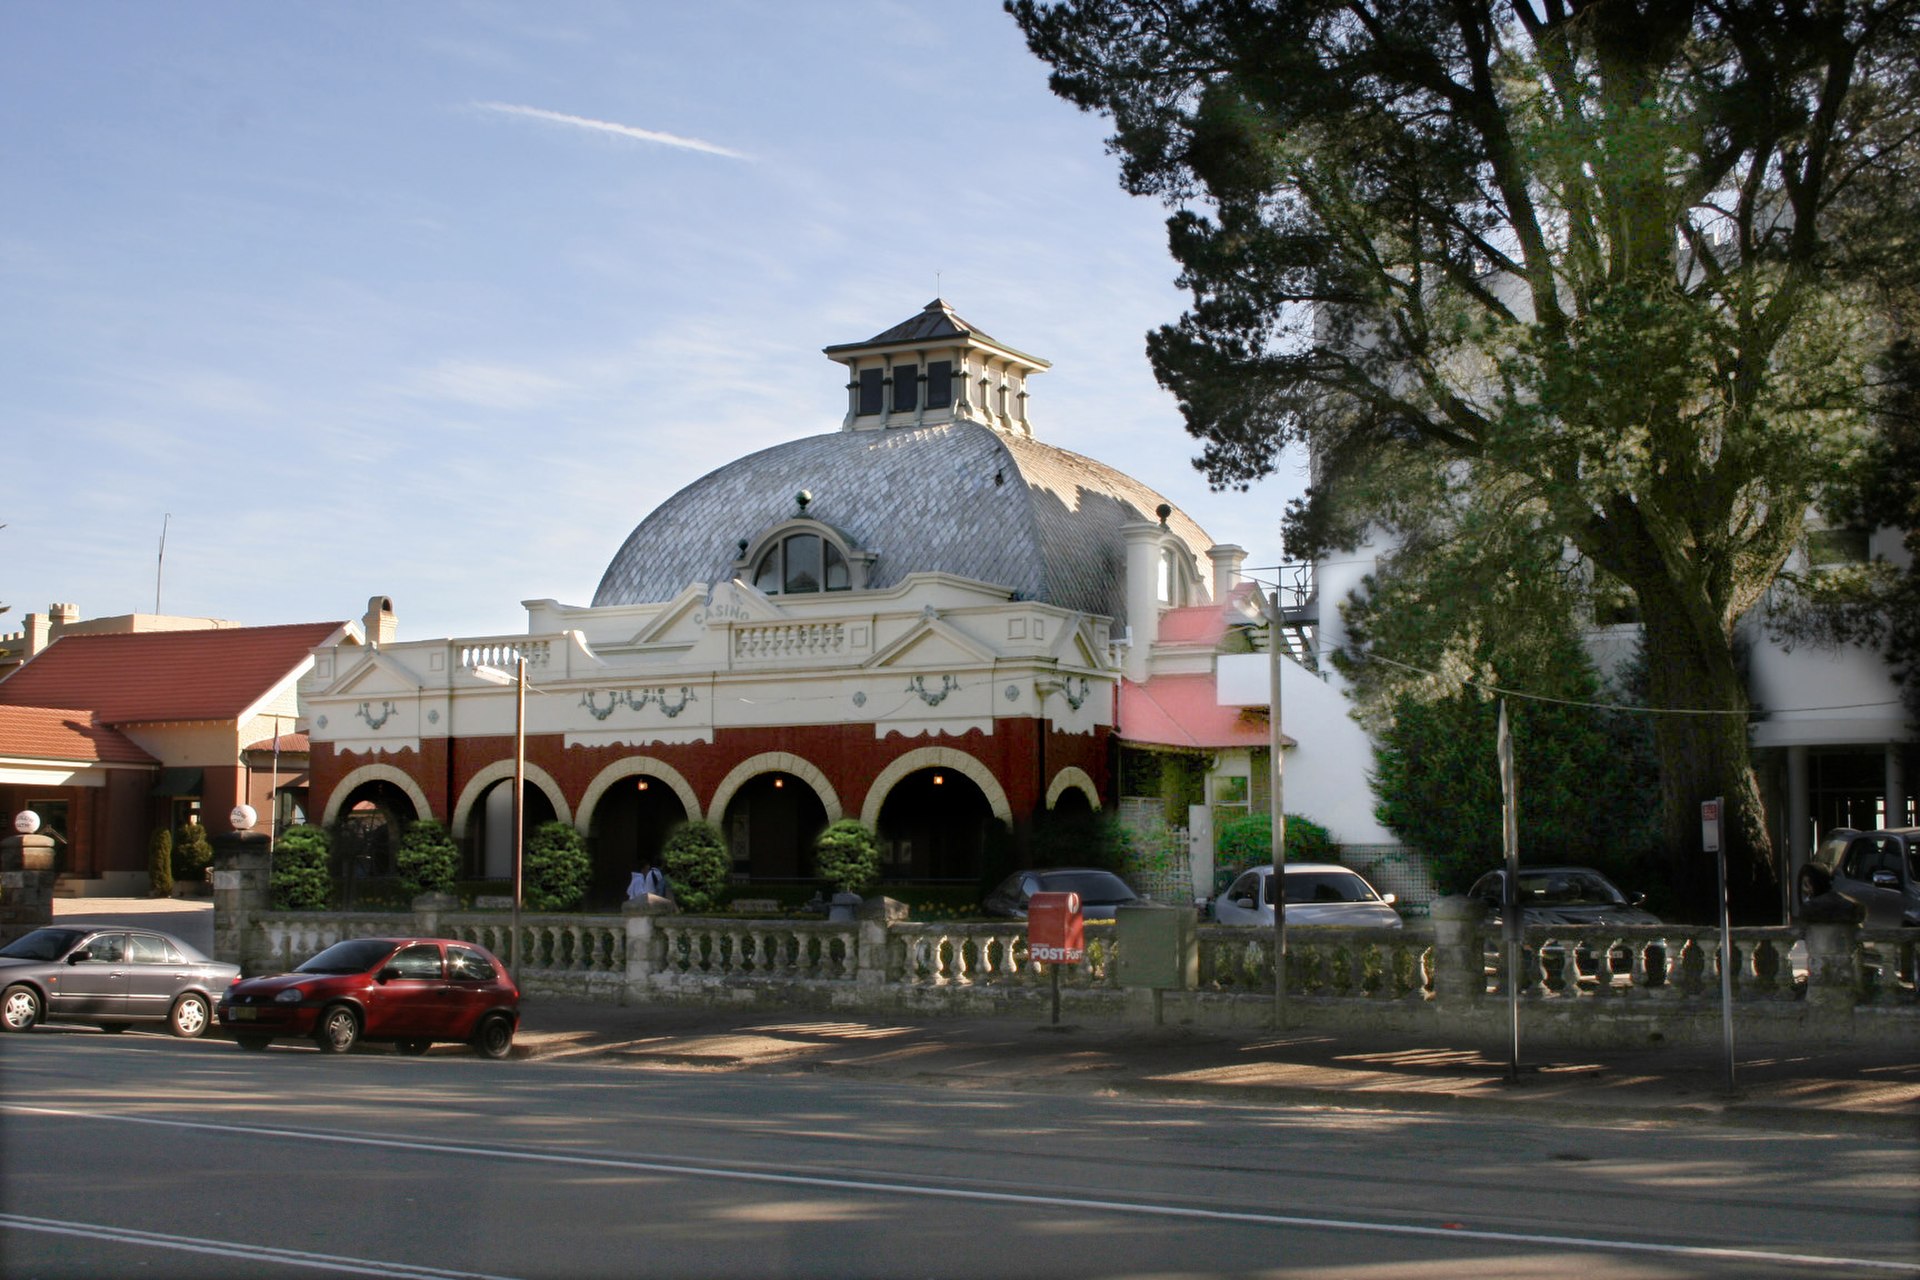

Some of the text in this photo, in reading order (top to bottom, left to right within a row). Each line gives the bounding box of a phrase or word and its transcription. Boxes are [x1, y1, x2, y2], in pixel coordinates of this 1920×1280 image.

[694, 604, 750, 625] CASINO
[1031, 947, 1064, 960] POST
[1065, 948, 1083, 960] POST
